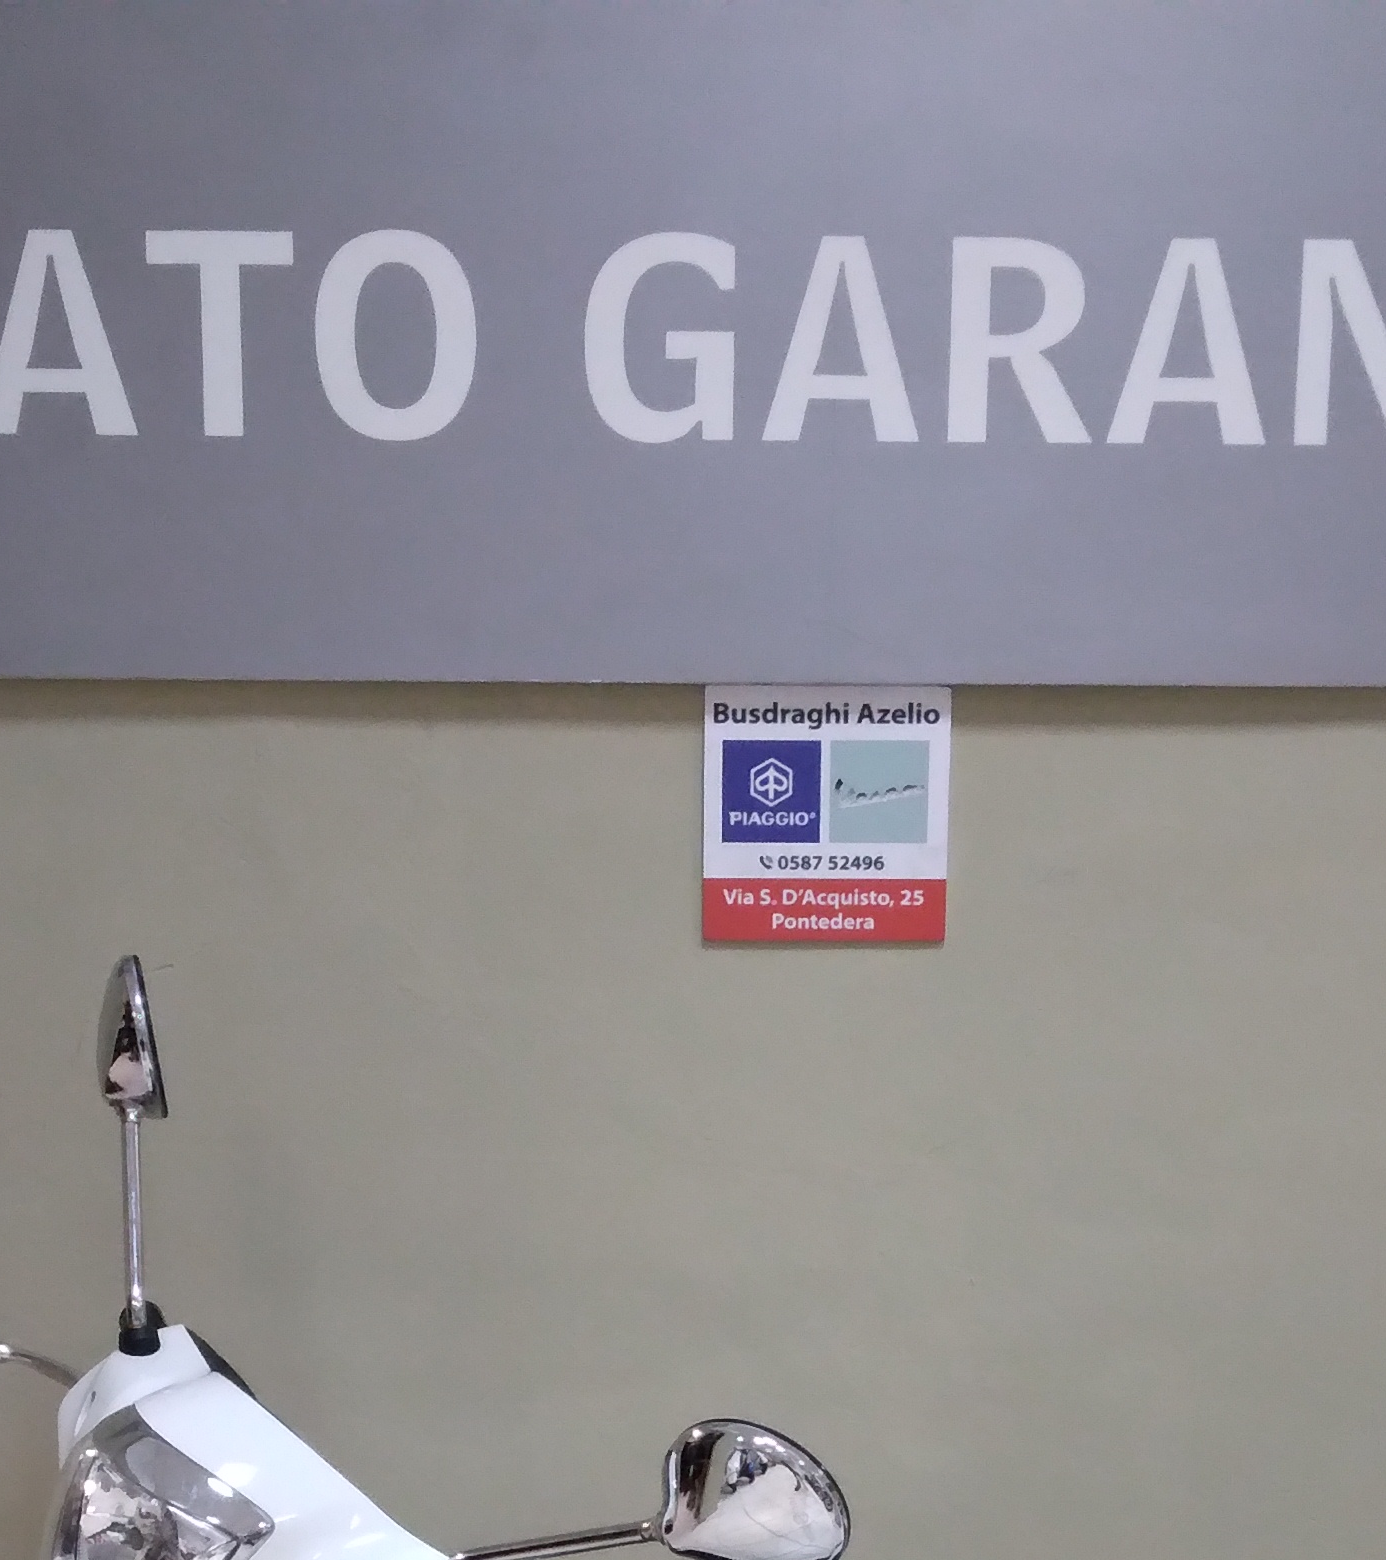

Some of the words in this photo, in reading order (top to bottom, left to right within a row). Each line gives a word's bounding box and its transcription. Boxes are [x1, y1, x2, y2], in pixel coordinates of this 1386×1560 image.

[712, 701, 850, 730] Busdraghi
[856, 702, 941, 725] Azelio
[777, 855, 822, 871] 0587
[827, 855, 885, 871] 52496
[722, 888, 755, 906] Via
[758, 888, 778, 906] S.
[899, 889, 926, 906] 25
[770, 912, 876, 931] Pontedera
